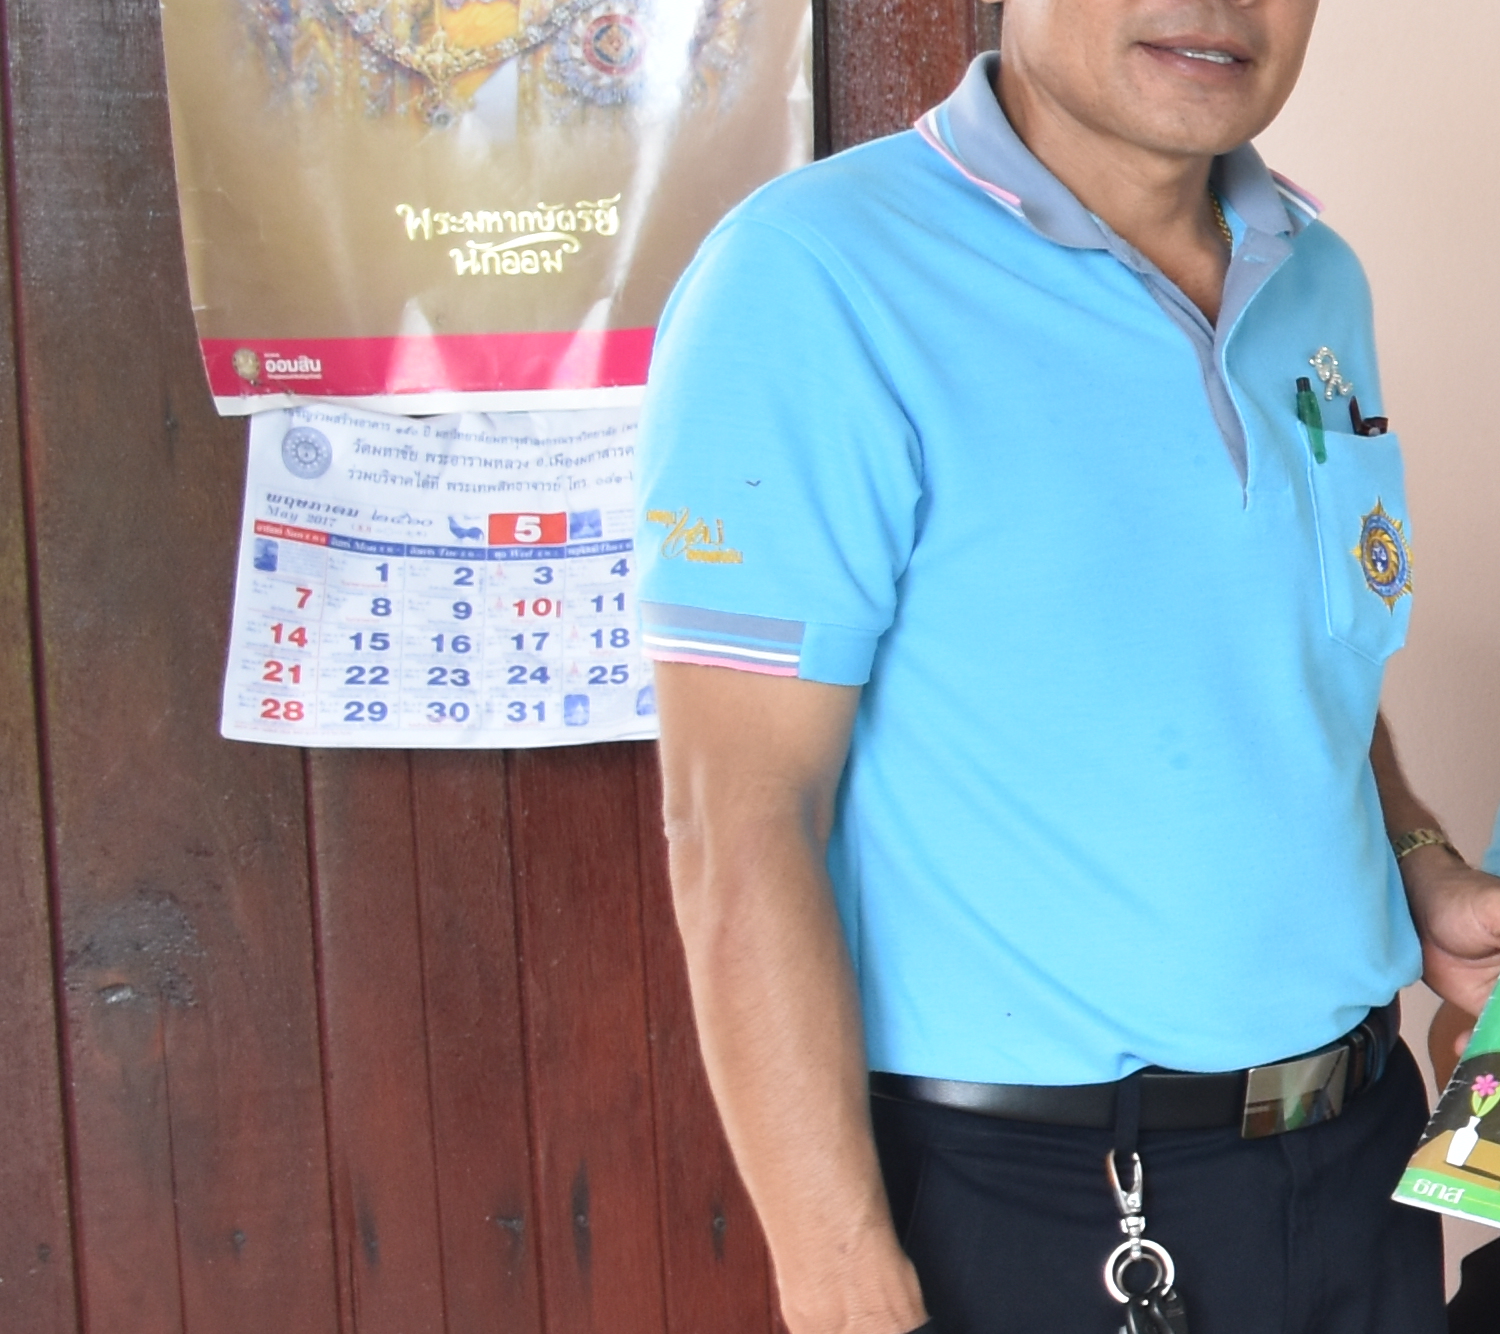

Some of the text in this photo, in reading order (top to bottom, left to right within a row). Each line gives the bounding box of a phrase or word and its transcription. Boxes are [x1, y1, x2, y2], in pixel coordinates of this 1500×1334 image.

[396, 193, 621, 241] พระมหากษัตริย์
[449, 231, 581, 276] นักออม
[264, 354, 322, 373] ออมสิน
[265, 504, 338, 529] May 2017
[266, 491, 360, 519] พฤษภาคม
[513, 515, 542, 543] 5
[375, 558, 629, 586] 1 2 3 4
[295, 587, 626, 620] 7 8 9 10 11
[270, 623, 630, 653] 14 15 16 17 18
[262, 661, 629, 687] 21 22 23 24 25
[261, 698, 546, 723] 28 29 30 31
